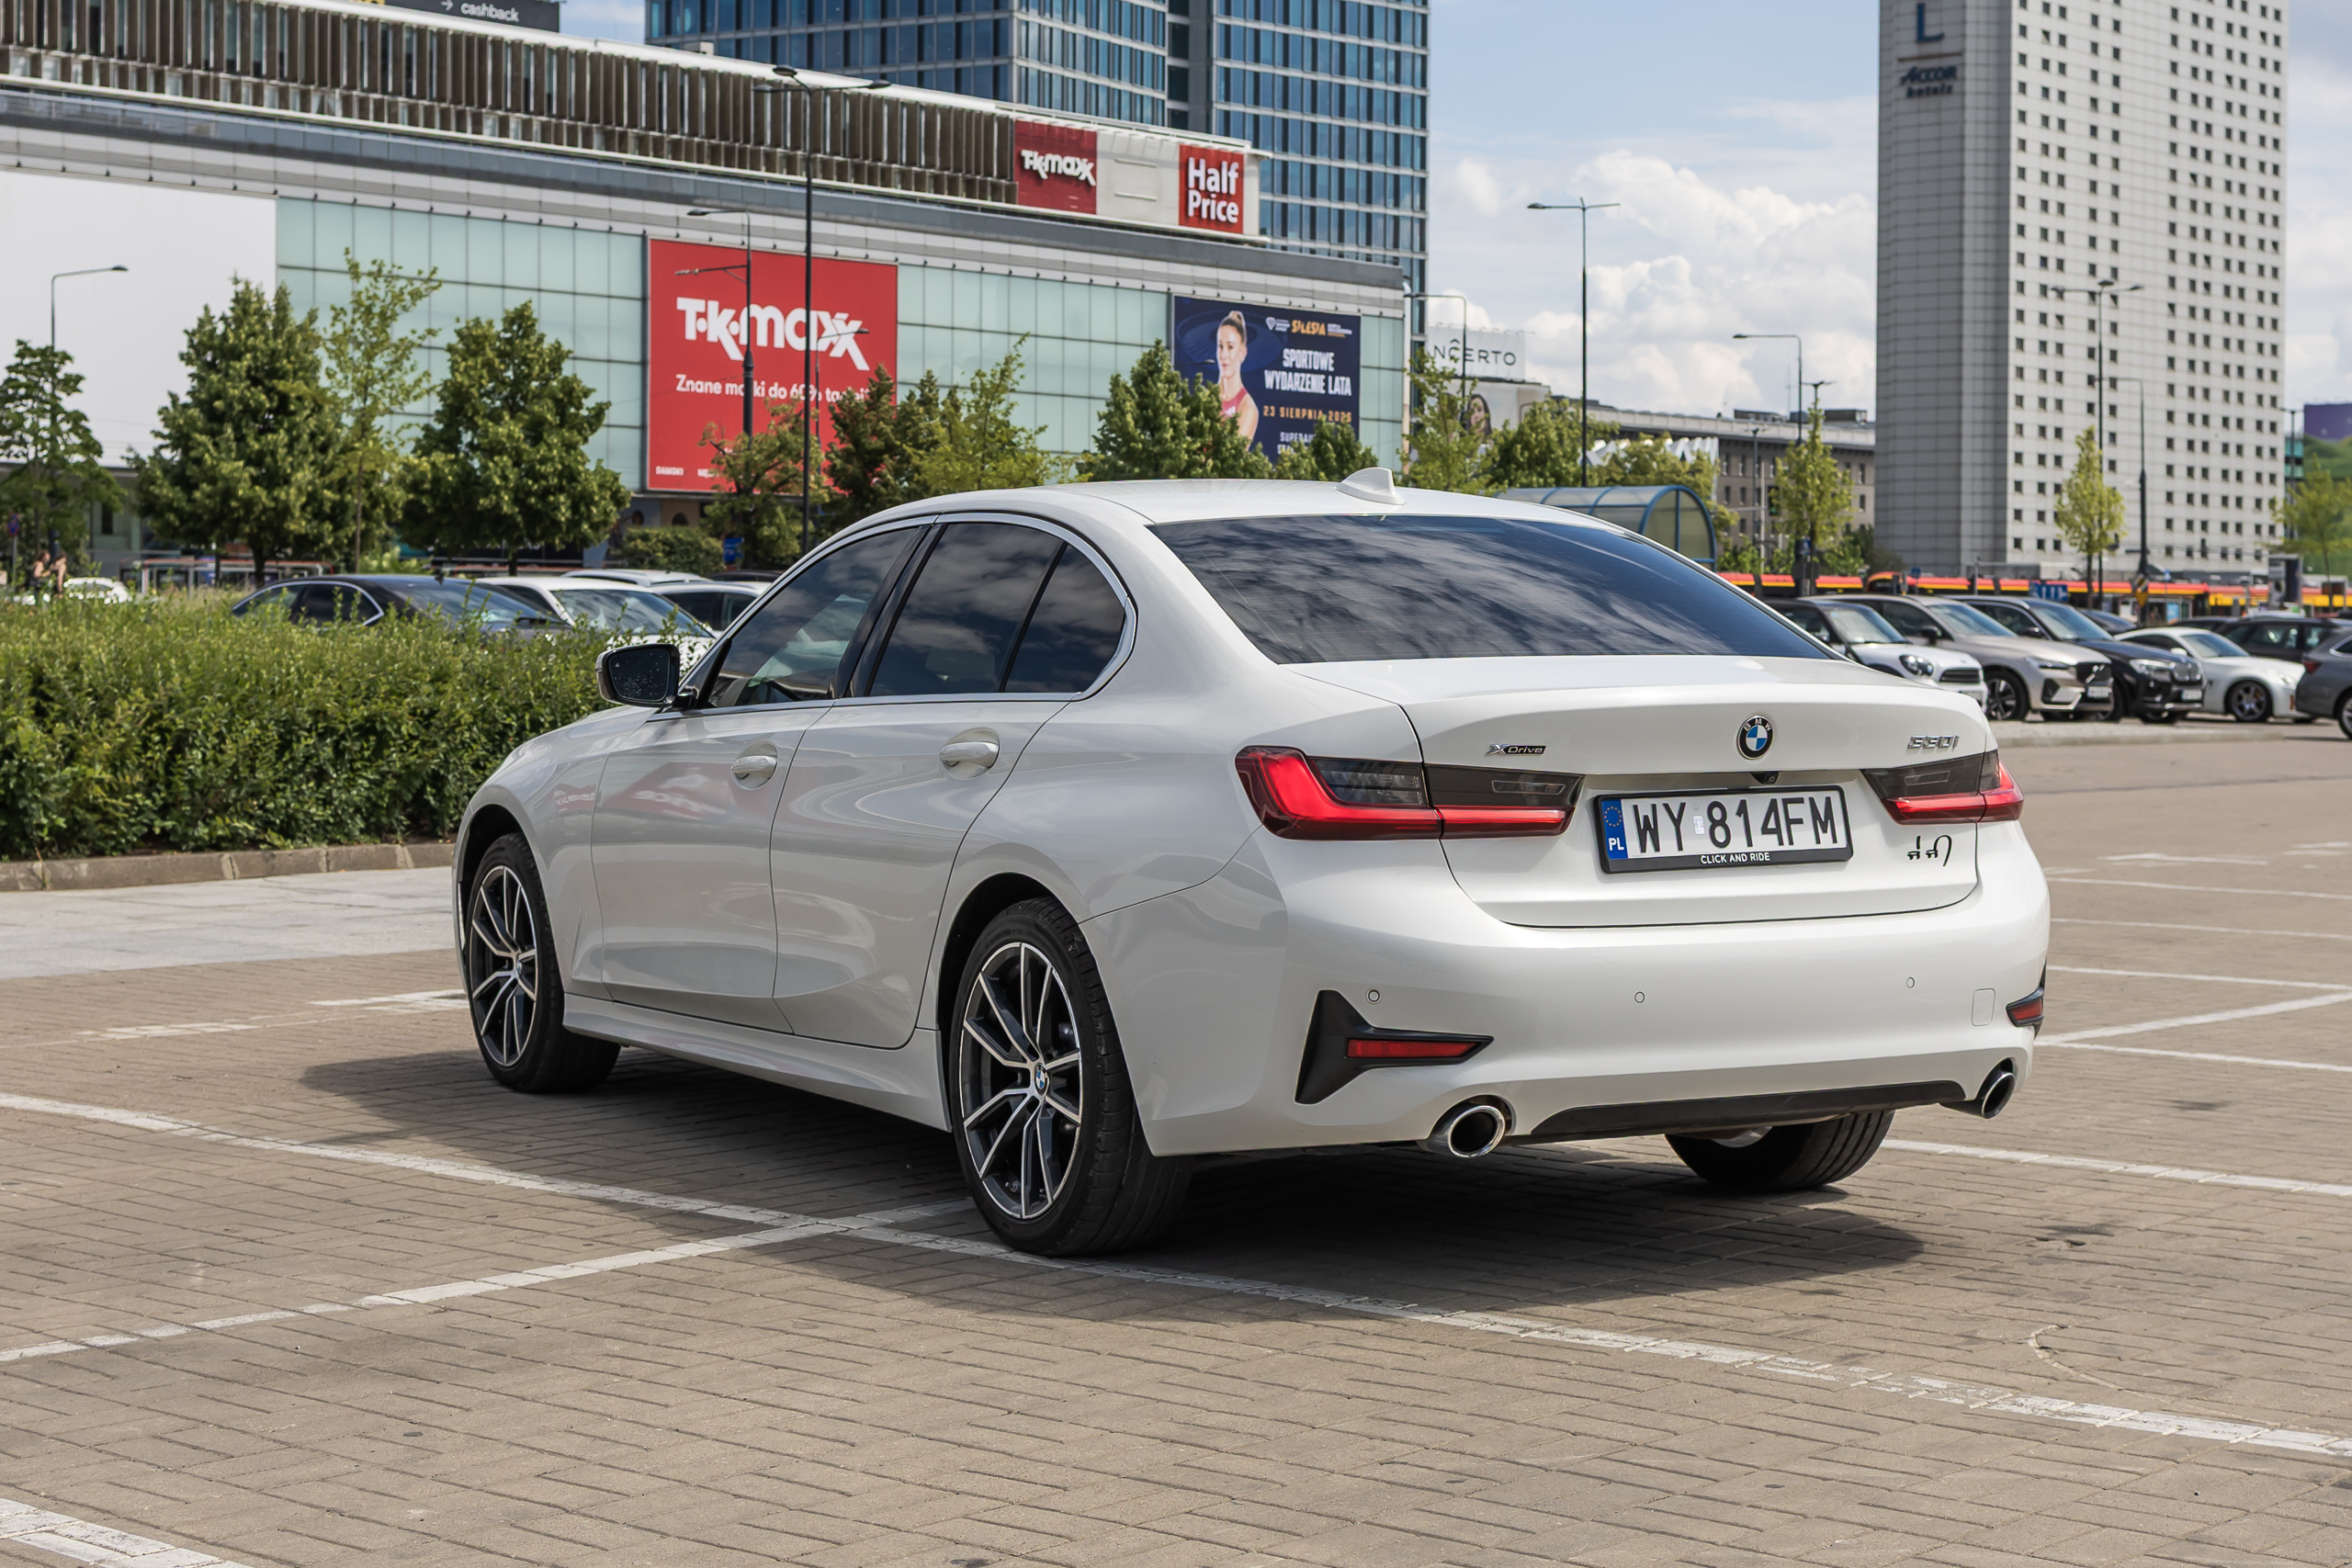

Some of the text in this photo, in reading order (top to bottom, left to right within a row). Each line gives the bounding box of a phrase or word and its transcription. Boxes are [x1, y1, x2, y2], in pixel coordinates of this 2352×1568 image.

[460, 3, 520, 23] cashback
[1188, 157, 1239, 195] Half
[1188, 189, 1239, 223] Price
[1283, 348, 1335, 372] SPORTOWE
[675, 374, 722, 395] Znane
[725, 380, 766, 399] maki
[768, 381, 787, 400] do
[1264, 369, 1352, 397] WYDARZENIE LATA
[1263, 405, 1275, 417] 23
[1280, 407, 1324, 420] SIERPNIA
[1632, 795, 1838, 854] WY 814FM
[1608, 837, 1625, 852] PL
[1701, 852, 1770, 864] CLICK AND RIDE
